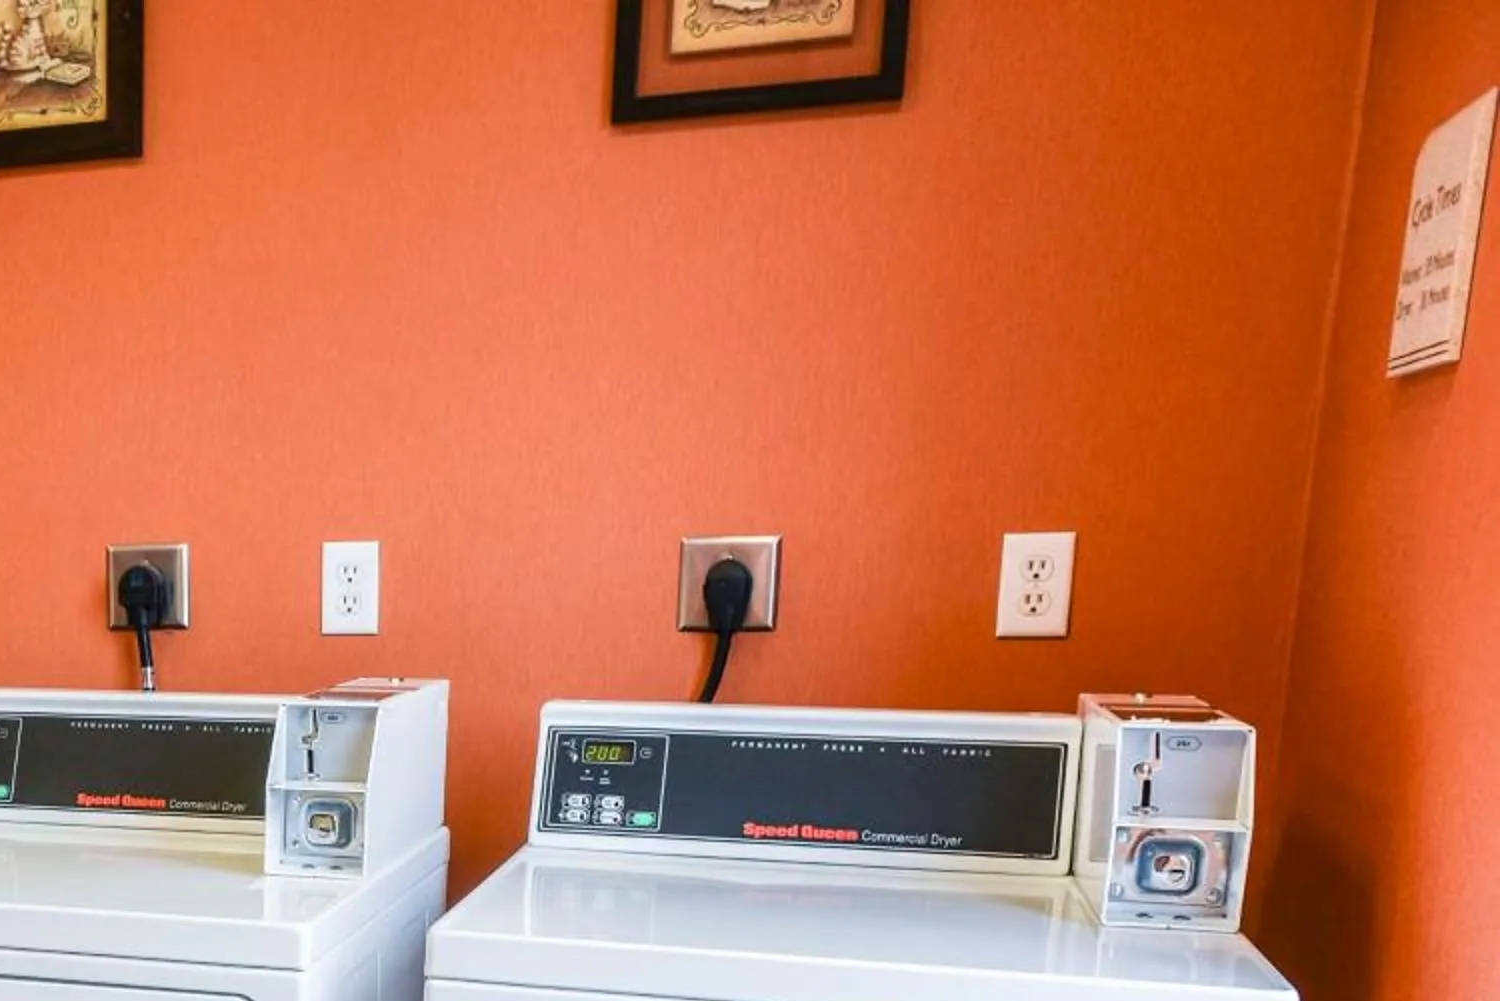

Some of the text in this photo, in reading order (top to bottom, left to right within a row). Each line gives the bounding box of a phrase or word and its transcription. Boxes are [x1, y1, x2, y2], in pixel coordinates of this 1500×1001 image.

[585, 745, 621, 762] 200
[76, 792, 121, 806] Speed
[122, 794, 166, 809] Queen
[743, 821, 963, 848] Speed Queen Commercial Dryer
